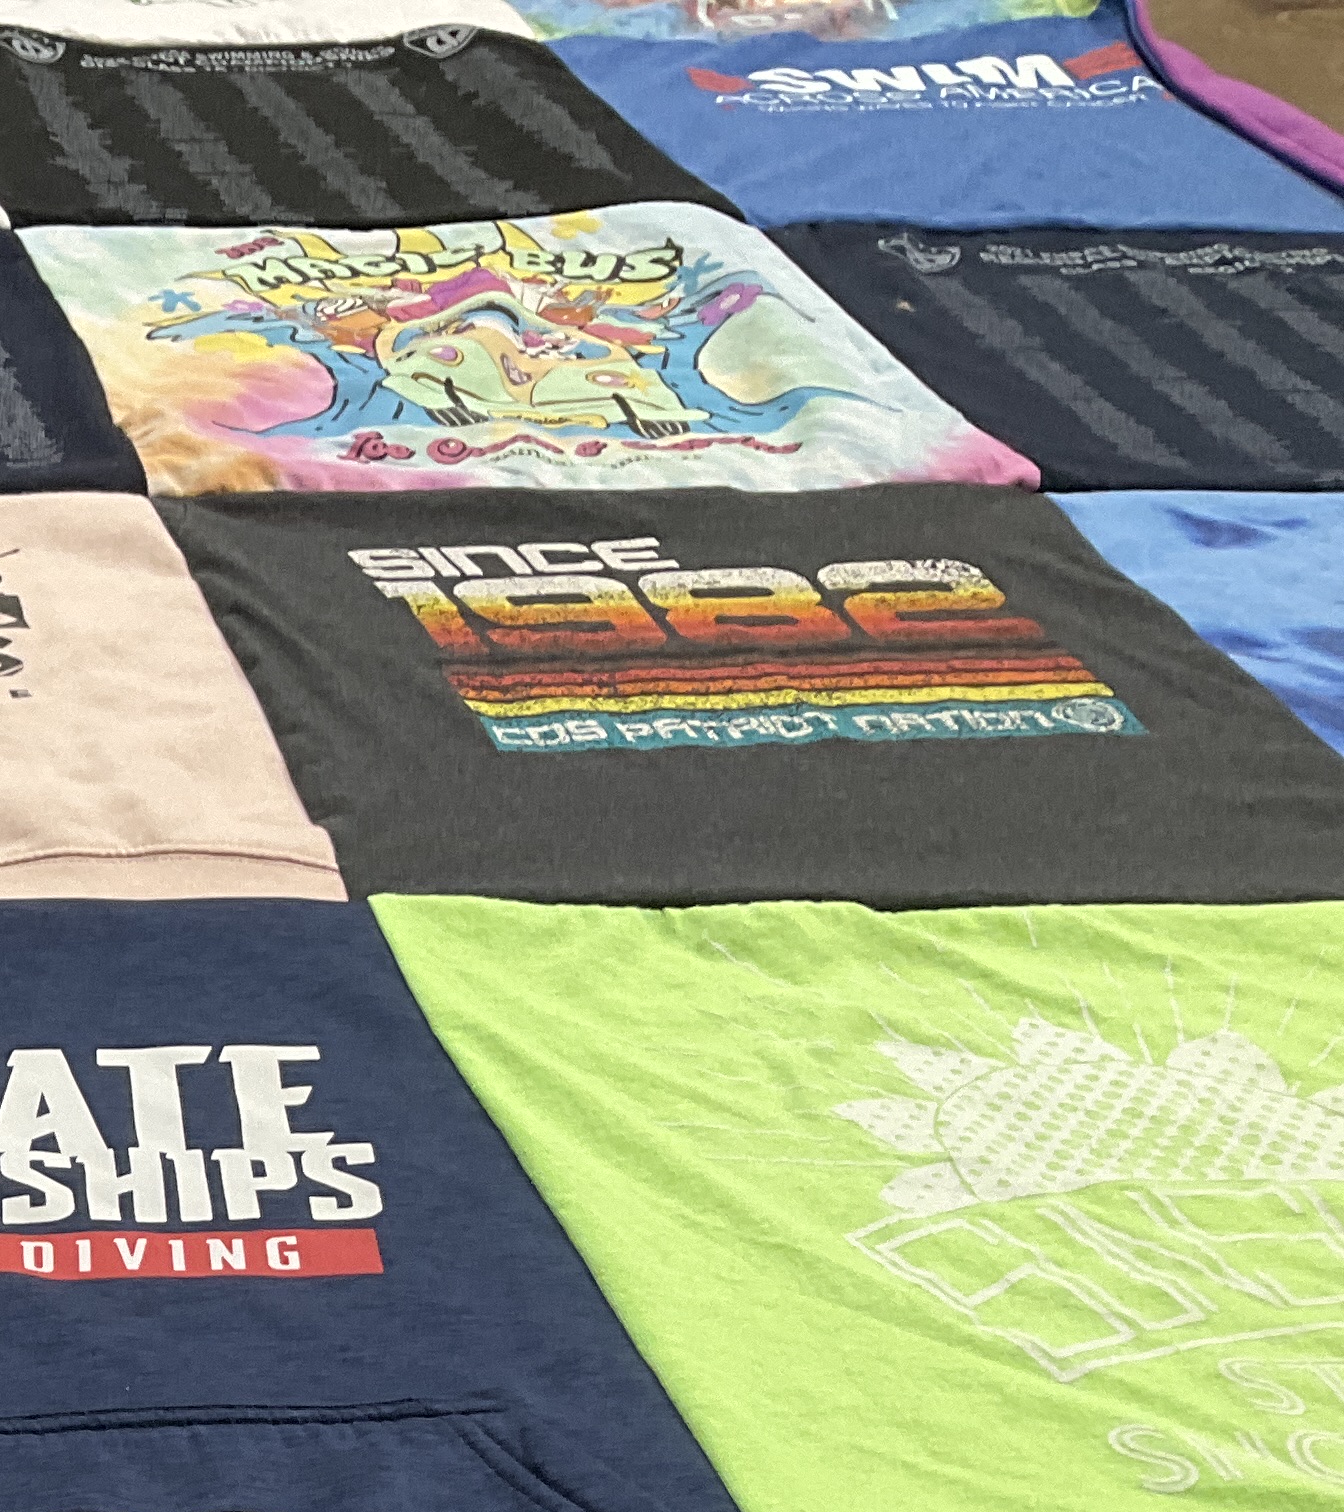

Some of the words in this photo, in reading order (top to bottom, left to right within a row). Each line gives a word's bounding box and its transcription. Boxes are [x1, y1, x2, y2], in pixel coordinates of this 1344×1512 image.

[748, 55, 1075, 94] SWIM
[512, 238, 684, 281] BUS
[346, 536, 680, 580] SINCE
[375, 558, 1044, 656] 1982
[21, 1232, 303, 1275] DIVING
